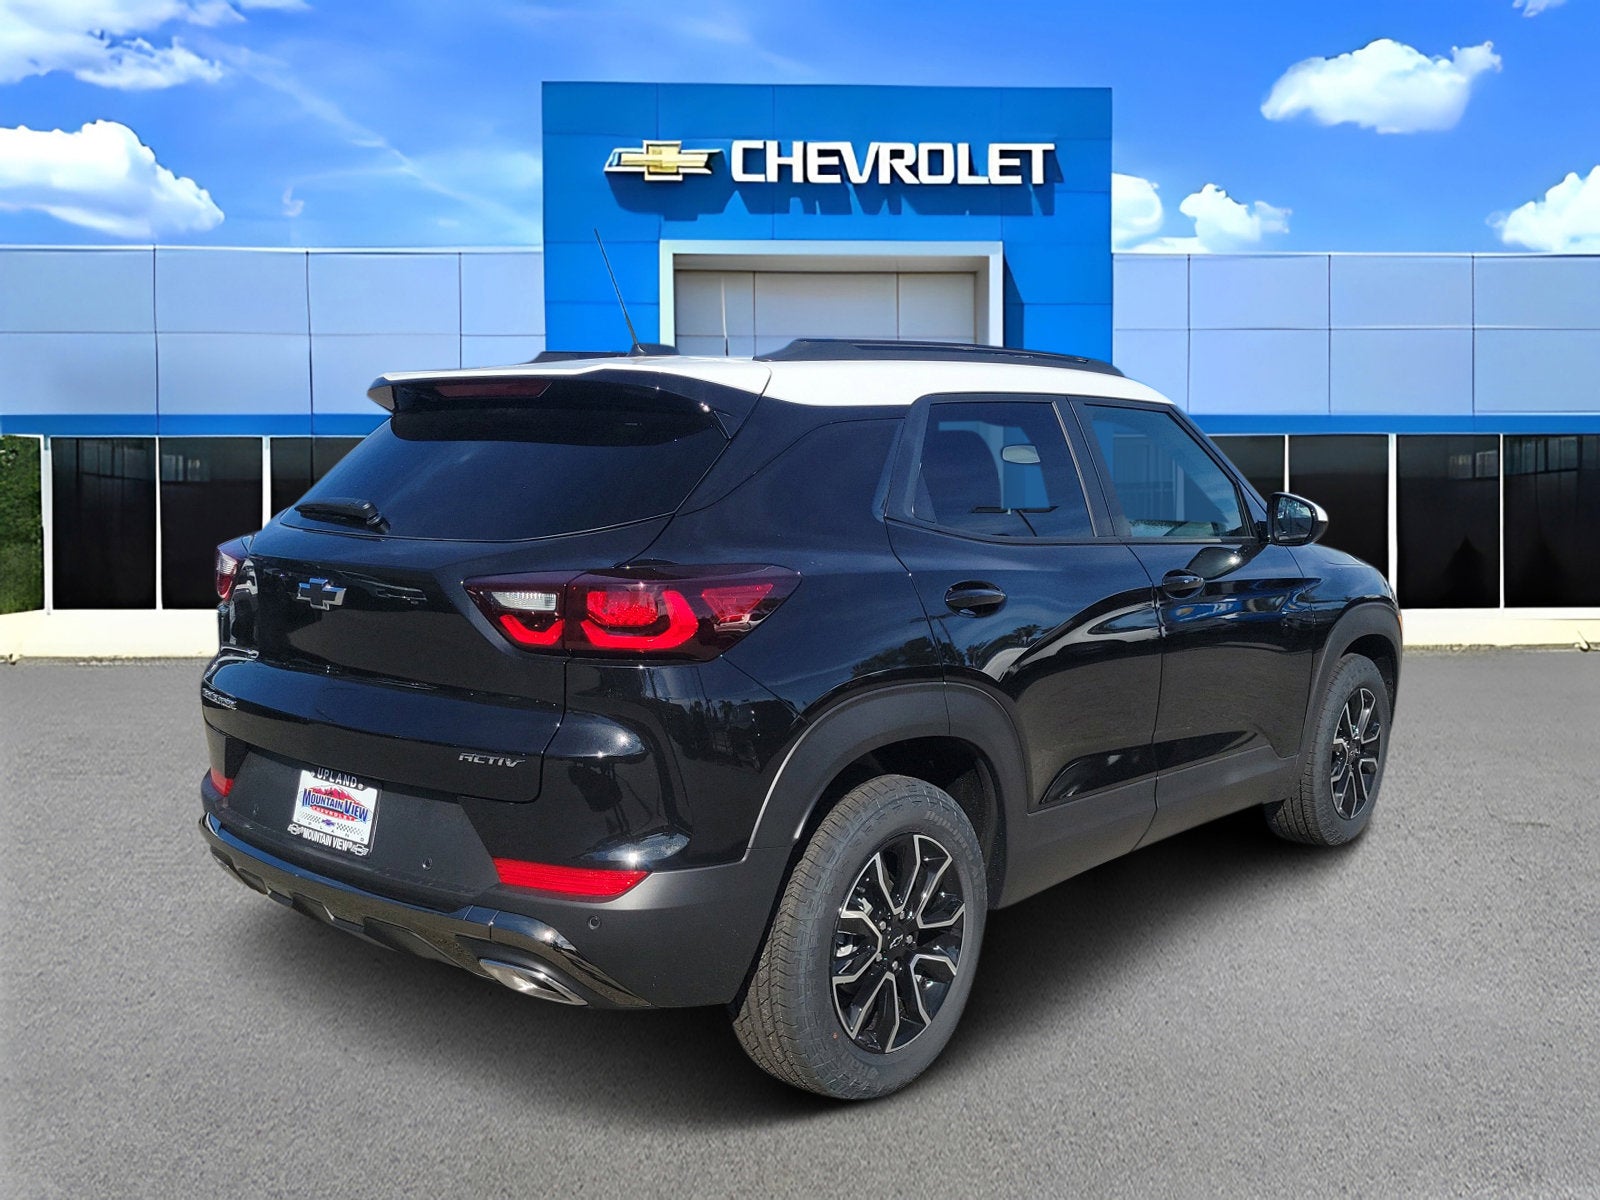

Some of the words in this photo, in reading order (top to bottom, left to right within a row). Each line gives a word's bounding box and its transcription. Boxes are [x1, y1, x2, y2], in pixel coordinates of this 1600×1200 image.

[730, 140, 1055, 186] CHEVROLET
[459, 752, 526, 768] ACTIV
[316, 768, 357, 787] UPLAND
[302, 788, 344, 810] MOUNTAIN
[344, 799, 368, 822] VIEW
[302, 827, 333, 847] MOUNTAIN
[332, 836, 350, 852] VIEW
